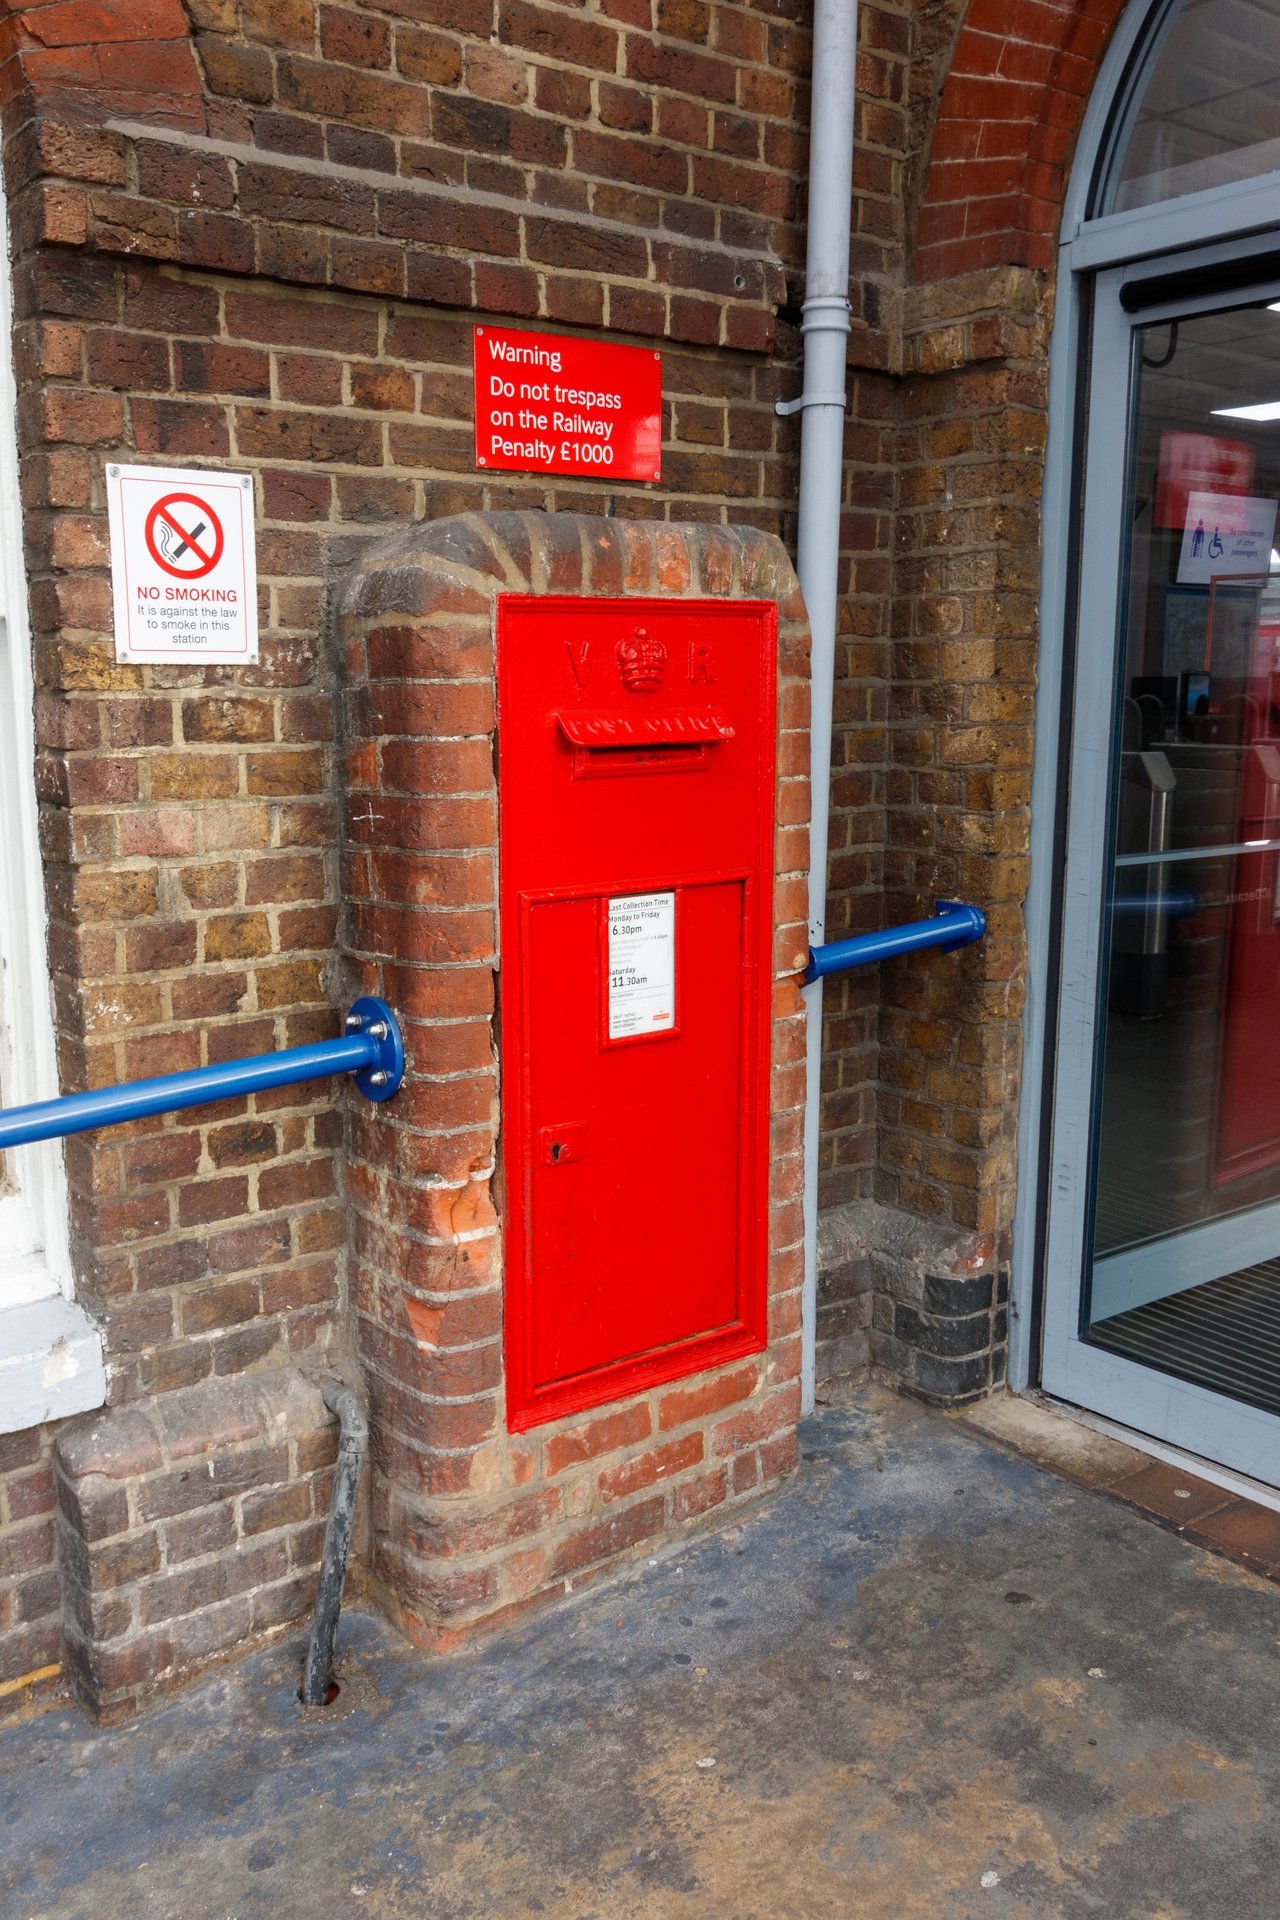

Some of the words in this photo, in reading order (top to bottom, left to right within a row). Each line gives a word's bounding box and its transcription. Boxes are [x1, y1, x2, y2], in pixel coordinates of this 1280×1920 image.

[489, 339, 562, 372] Warning
[490, 376, 515, 397] Do
[520, 383, 550, 401] not
[554, 385, 621, 410] trespass
[491, 411, 513, 427] on
[518, 409, 548, 429] the
[553, 412, 613, 441] Railway
[491, 435, 555, 464] Penalty
[560, 442, 613, 464] £1000
[137, 586, 160, 600] NO
[165, 587, 237, 603] SMOKING
[137, 605, 145, 615] It
[148, 605, 157, 616] is
[160, 606, 198, 618] against
[201, 606, 217, 618] the
[220, 607, 238, 618] law
[147, 619, 158, 629] to
[161, 620, 197, 630] smoke
[199, 620, 209, 630] in
[211, 620, 230, 631] this
[172, 634, 208, 644] station
[564, 641, 592, 688] V
[687, 641, 717, 683] R
[622, 900, 653, 910] Collection
[654, 898, 669, 906] Time
[609, 914, 632, 923] Monday
[641, 911, 660, 919] Friday
[612, 925, 642, 936] 6.30pm
[609, 966, 636, 976] Saturday
[611, 976, 648, 988] 11.30am
